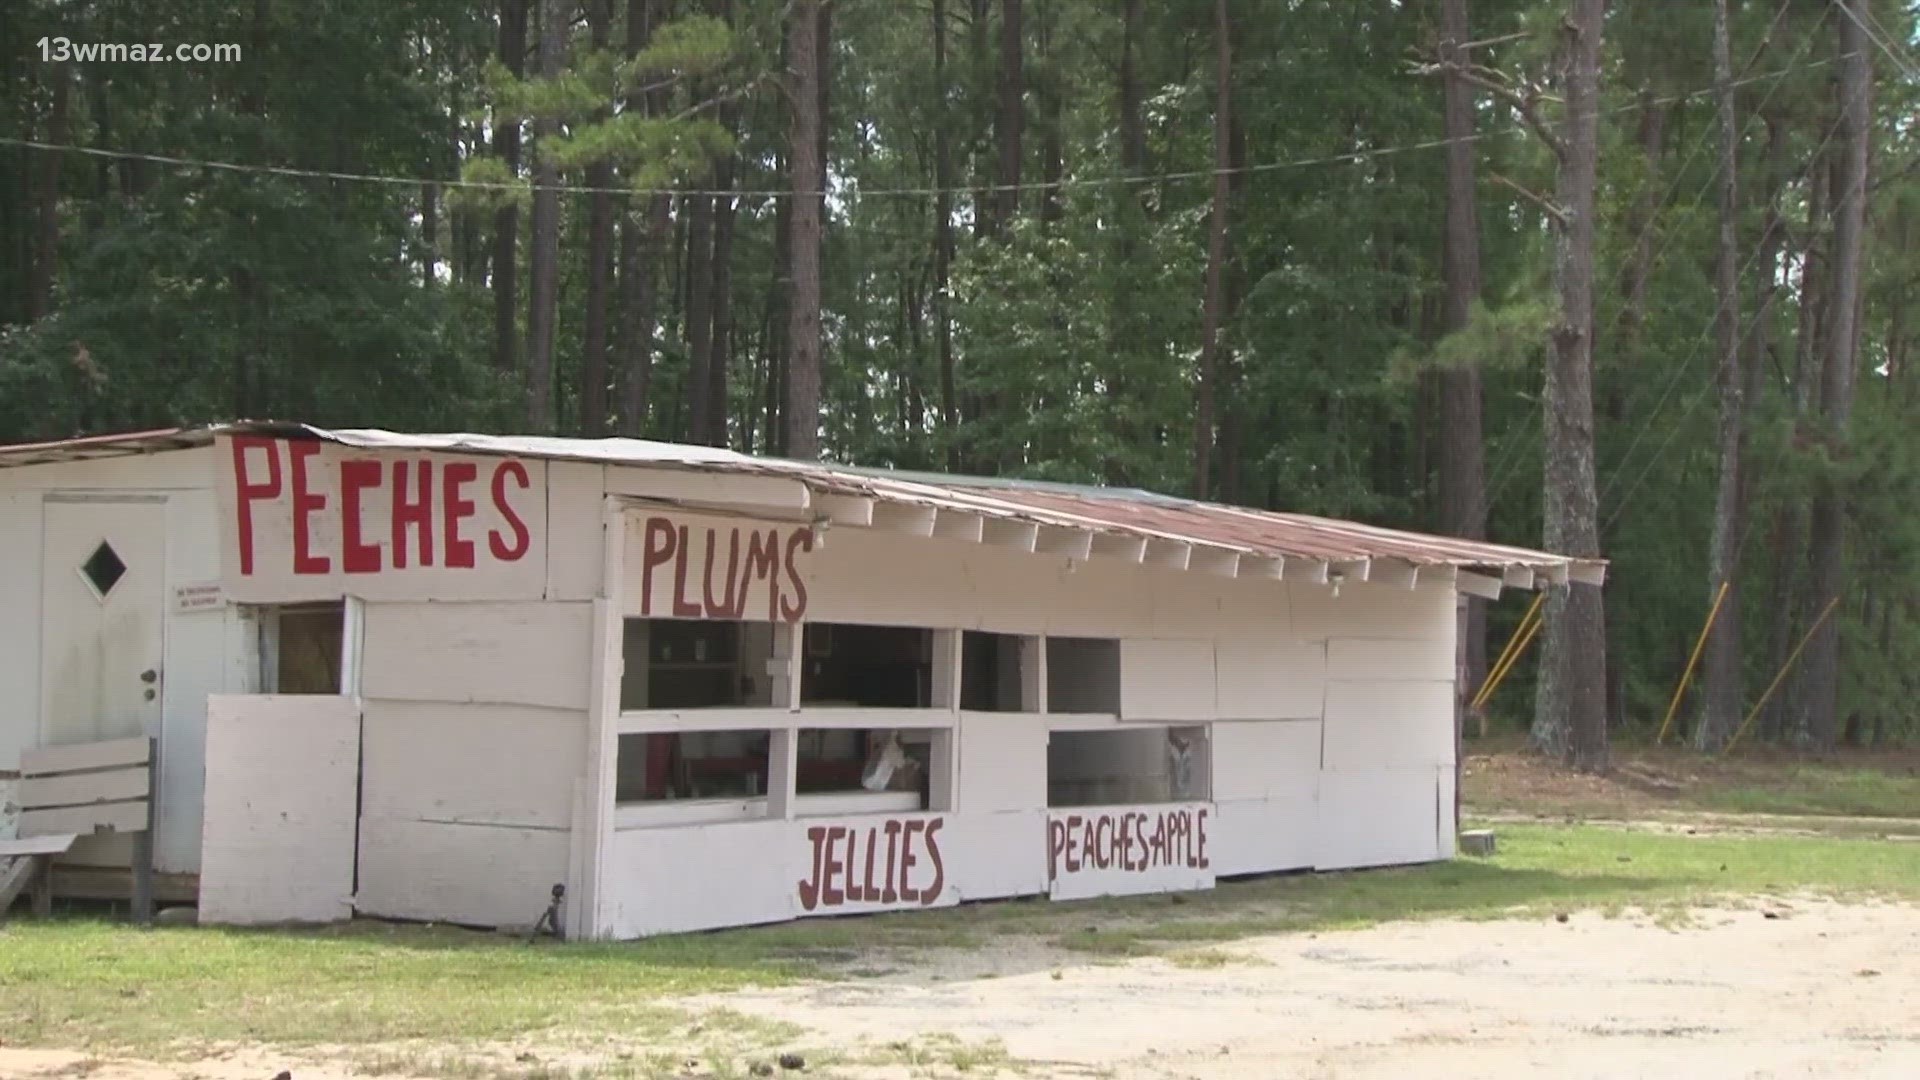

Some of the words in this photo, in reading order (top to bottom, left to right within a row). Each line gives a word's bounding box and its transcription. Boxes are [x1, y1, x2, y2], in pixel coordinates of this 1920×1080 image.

[232, 435, 529, 575] PECHES
[641, 517, 814, 623] PLUMS
[799, 817, 944, 911] JELLIES
